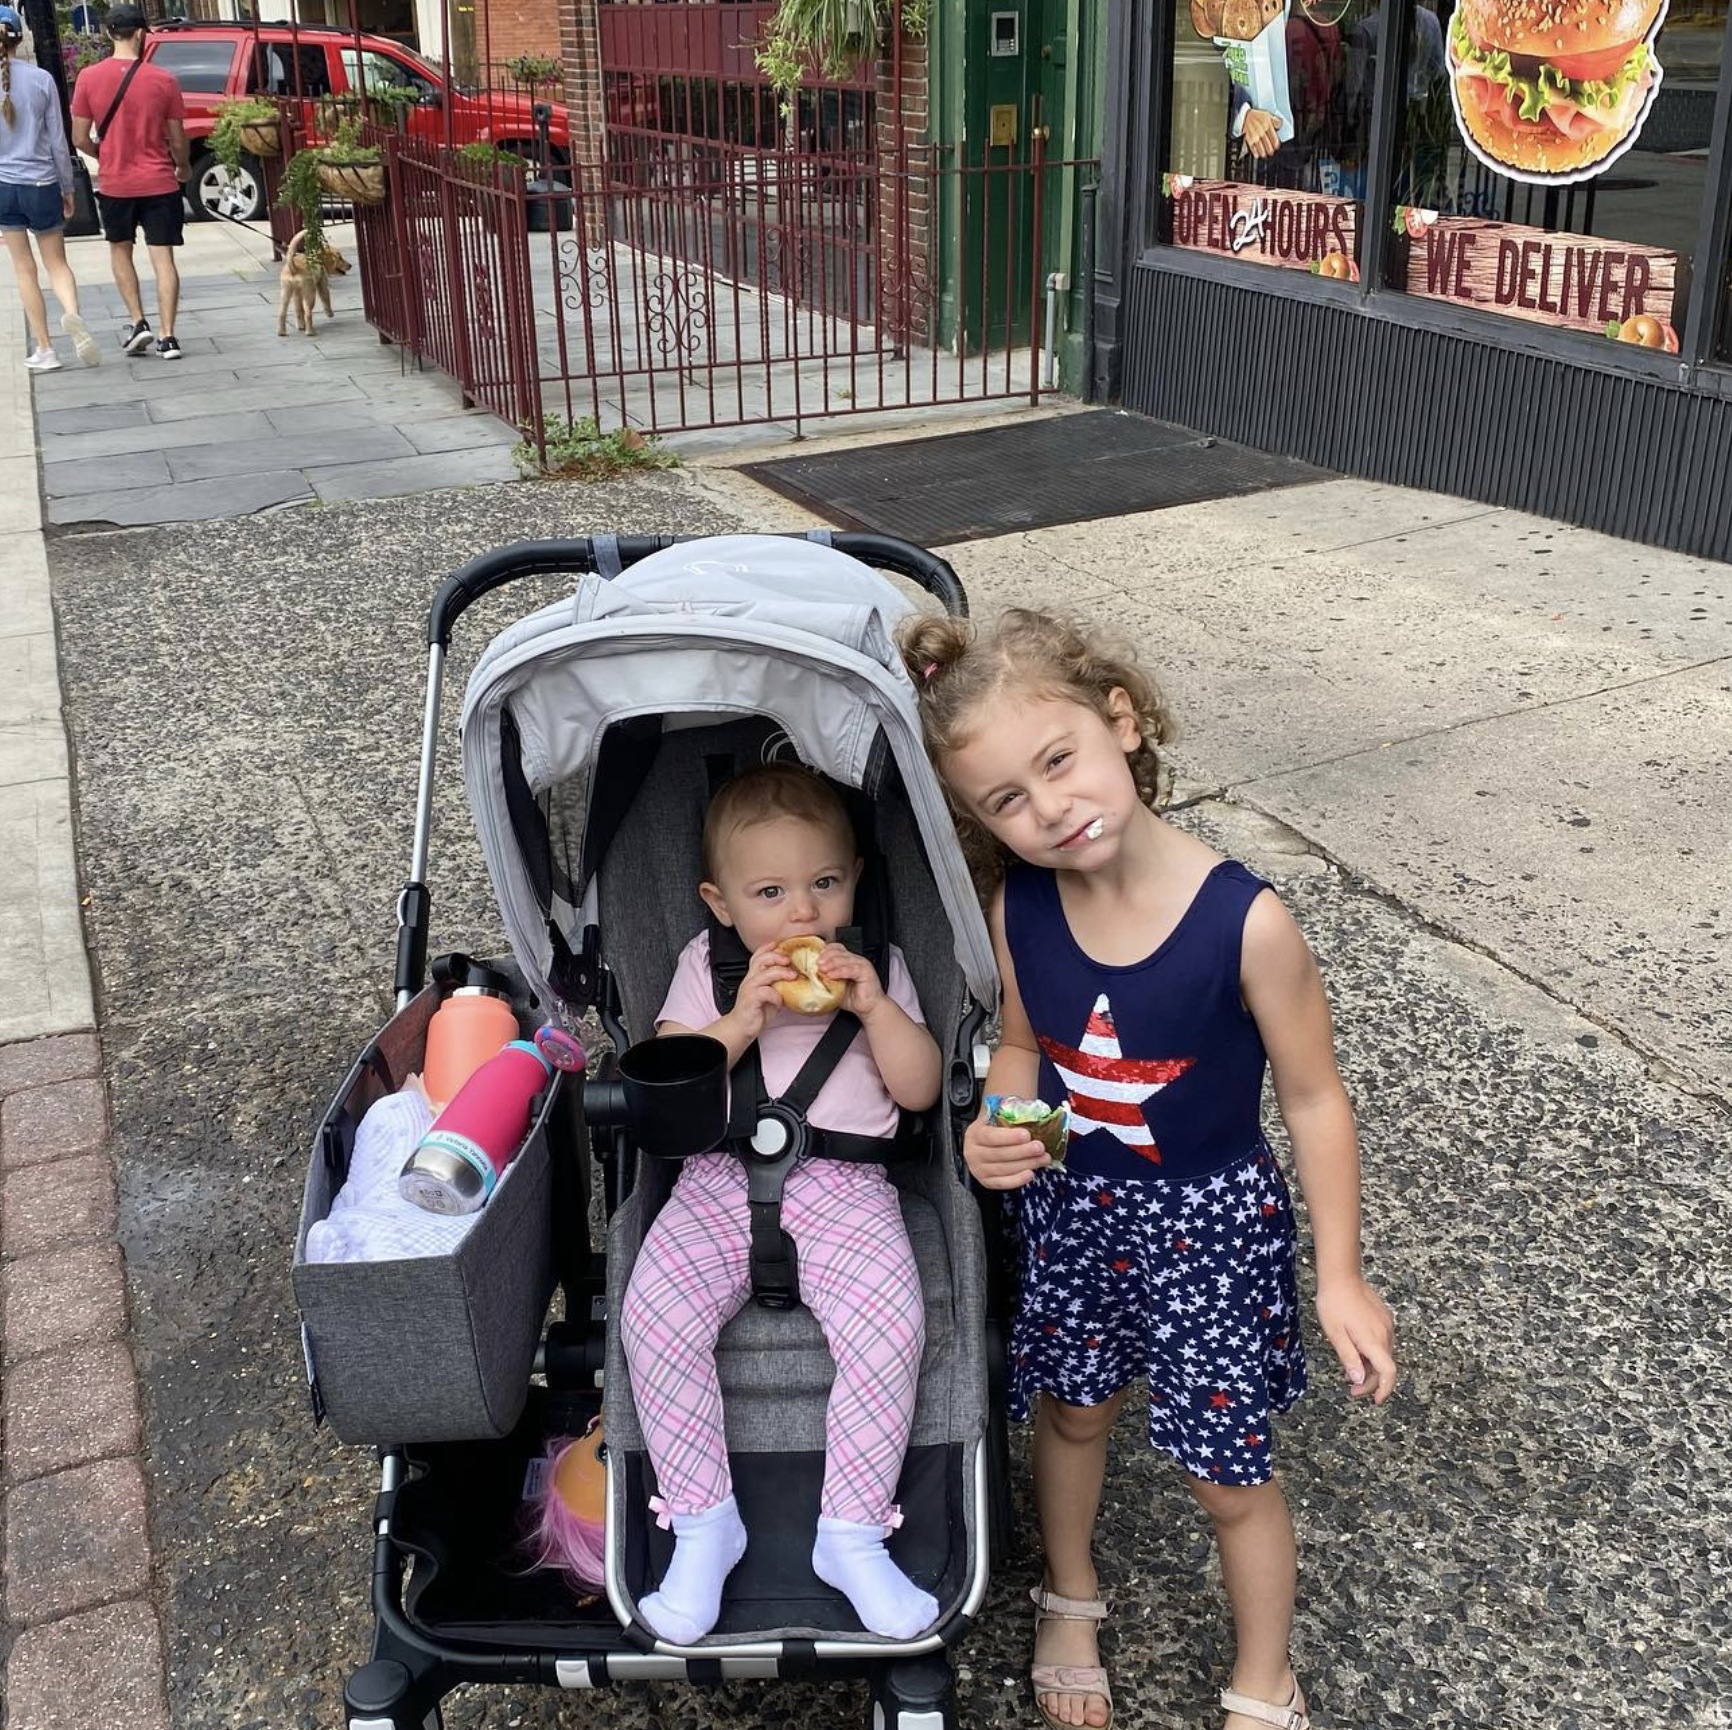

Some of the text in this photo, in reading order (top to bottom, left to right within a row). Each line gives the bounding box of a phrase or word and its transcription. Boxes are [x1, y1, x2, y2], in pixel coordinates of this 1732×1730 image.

[1178, 190, 1349, 262] OPEN 24 HOURS
[1427, 228, 1650, 323] WE DELIVER
